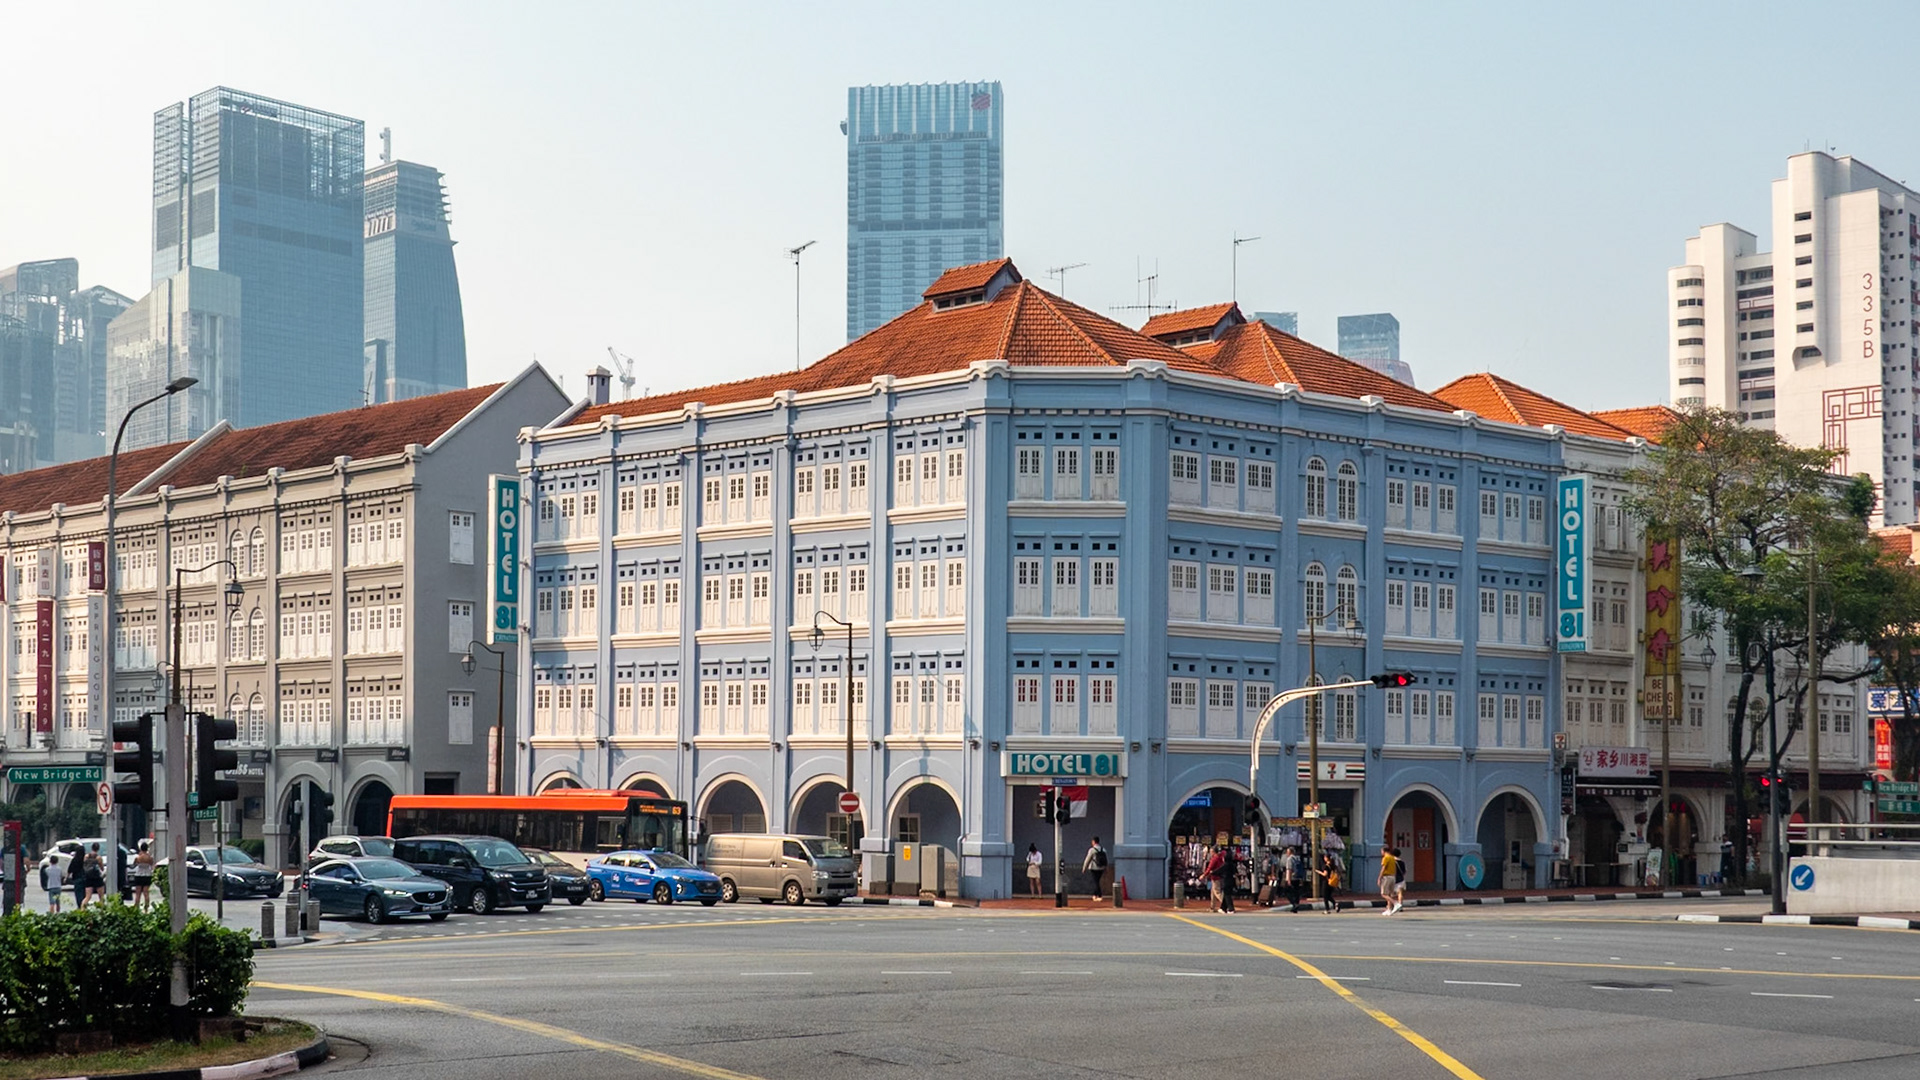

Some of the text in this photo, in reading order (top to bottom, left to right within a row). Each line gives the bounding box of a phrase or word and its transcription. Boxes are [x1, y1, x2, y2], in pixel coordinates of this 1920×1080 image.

[1863, 273, 1874, 358] 335B
[496, 488, 517, 629] HOTEL 81
[1560, 487, 1583, 638] HOTEL 81
[1646, 692, 1673, 702] CHEG
[248, 768, 264, 776] HOTEL
[1017, 754, 1118, 776] HOTEL 81
[1327, 763, 1337, 779] 7
[14, 769, 100, 781] New Bridge Rd
[1892, 783, 1910, 793] Bridge
[1911, 783, 1918, 792] Rd
[1396, 832, 1410, 848] Hi
